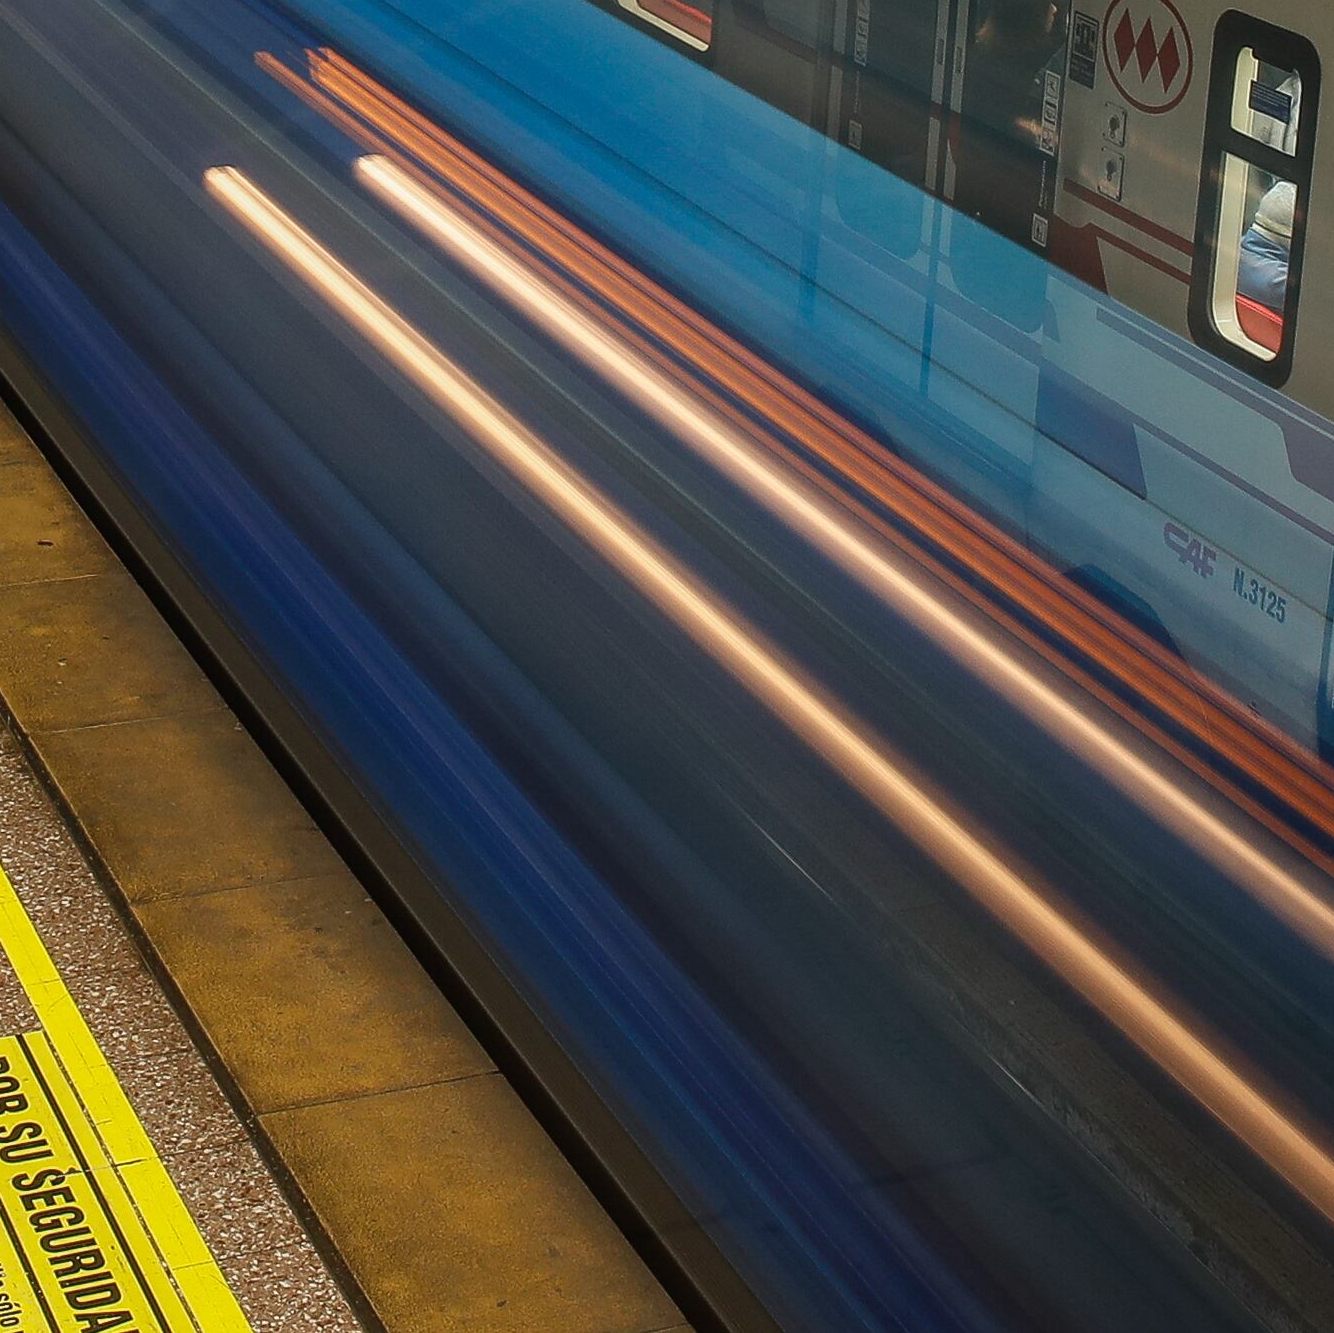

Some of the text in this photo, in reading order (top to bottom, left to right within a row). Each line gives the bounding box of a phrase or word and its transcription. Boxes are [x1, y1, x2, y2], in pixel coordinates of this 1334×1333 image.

[1163, 522, 1217, 578] CAF
[1233, 567, 1286, 623] N.3125
[12, 1168, 141, 1333] SEGURIDA
